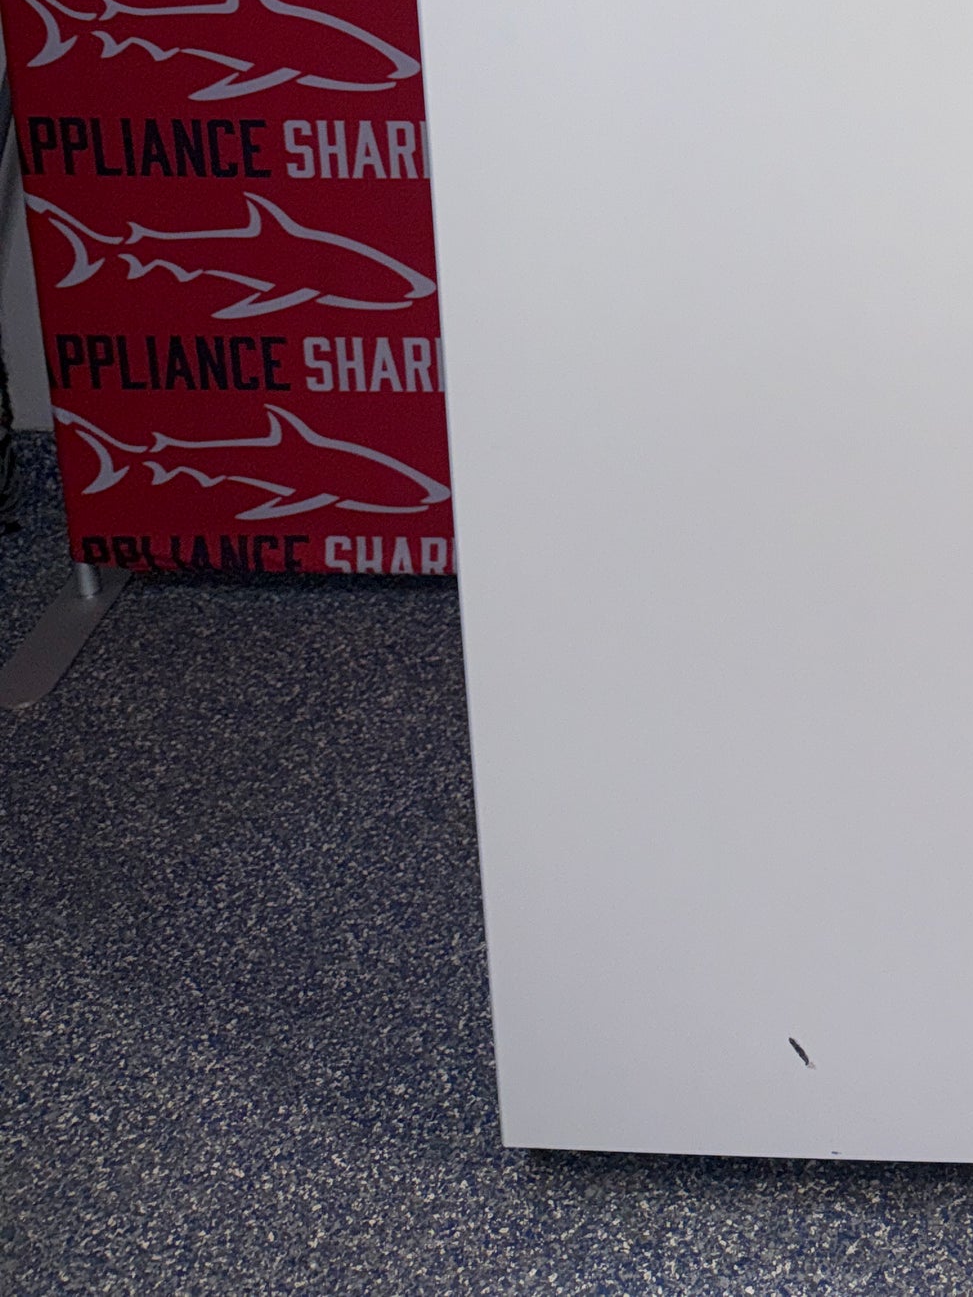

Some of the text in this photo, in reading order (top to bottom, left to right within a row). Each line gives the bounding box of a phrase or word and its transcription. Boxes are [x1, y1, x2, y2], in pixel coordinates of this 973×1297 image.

[21, 116, 430, 180] PPLIANCE SHAR
[51, 333, 444, 393] PPLIANCE SHAR
